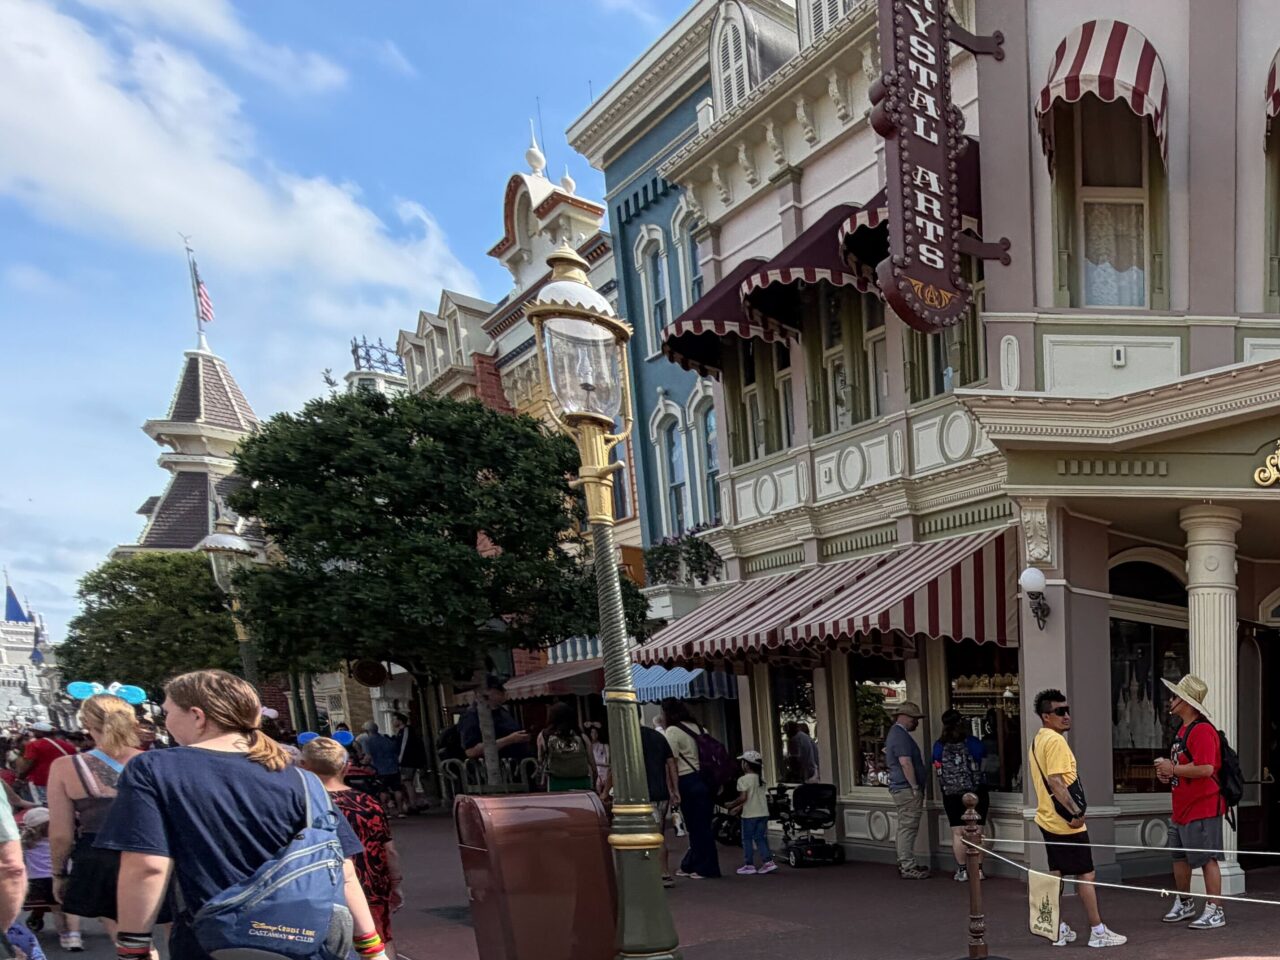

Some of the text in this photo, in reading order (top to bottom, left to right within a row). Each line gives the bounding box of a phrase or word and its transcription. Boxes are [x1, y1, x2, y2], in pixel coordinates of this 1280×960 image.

[905, 0, 945, 270] YSTAL ARTS
[248, 928, 287, 940] CASTAWAY
